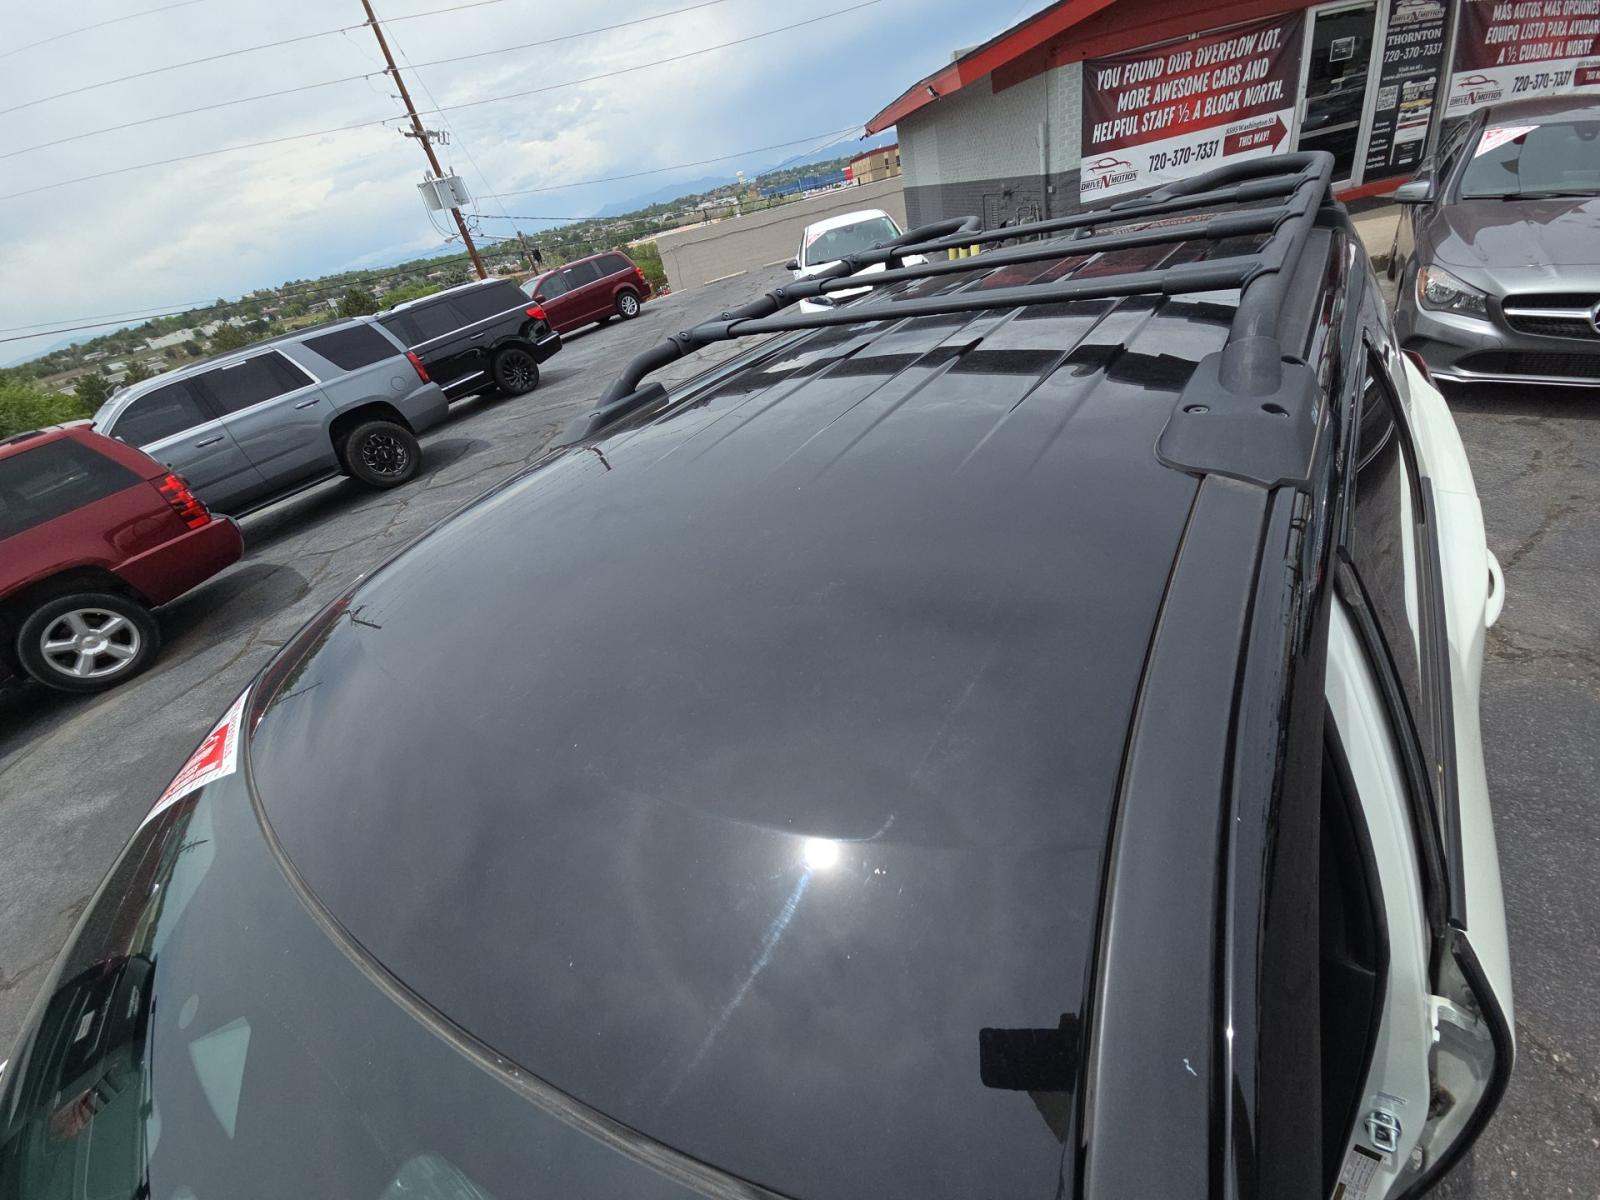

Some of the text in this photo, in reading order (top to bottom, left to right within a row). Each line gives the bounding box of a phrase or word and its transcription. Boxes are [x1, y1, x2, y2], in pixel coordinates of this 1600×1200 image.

[1513, 2, 1542, 19] AUTOS
[1387, 28, 1442, 46] THORNTON
[1485, 19, 1600, 44] EQUIPO LISTO PARA AYUDAR
[1097, 28, 1282, 91] YOU FOUND OUR OVERFLOW LOT.
[1496, 46, 1506, 64] A
[1519, 42, 1553, 61] CUADRA
[1554, 41, 1564, 58] AL
[1117, 57, 1269, 113] MORE AWESOME CARS AND
[1092, 116, 1139, 144] HELPFUL
[1141, 107, 1176, 134] STAFF
[1192, 100, 1201, 121] A
[1203, 93, 1240, 118] BLOCK
[1243, 80, 1284, 107] NORTH.
[1239, 130, 1270, 147] THIS WAY!
